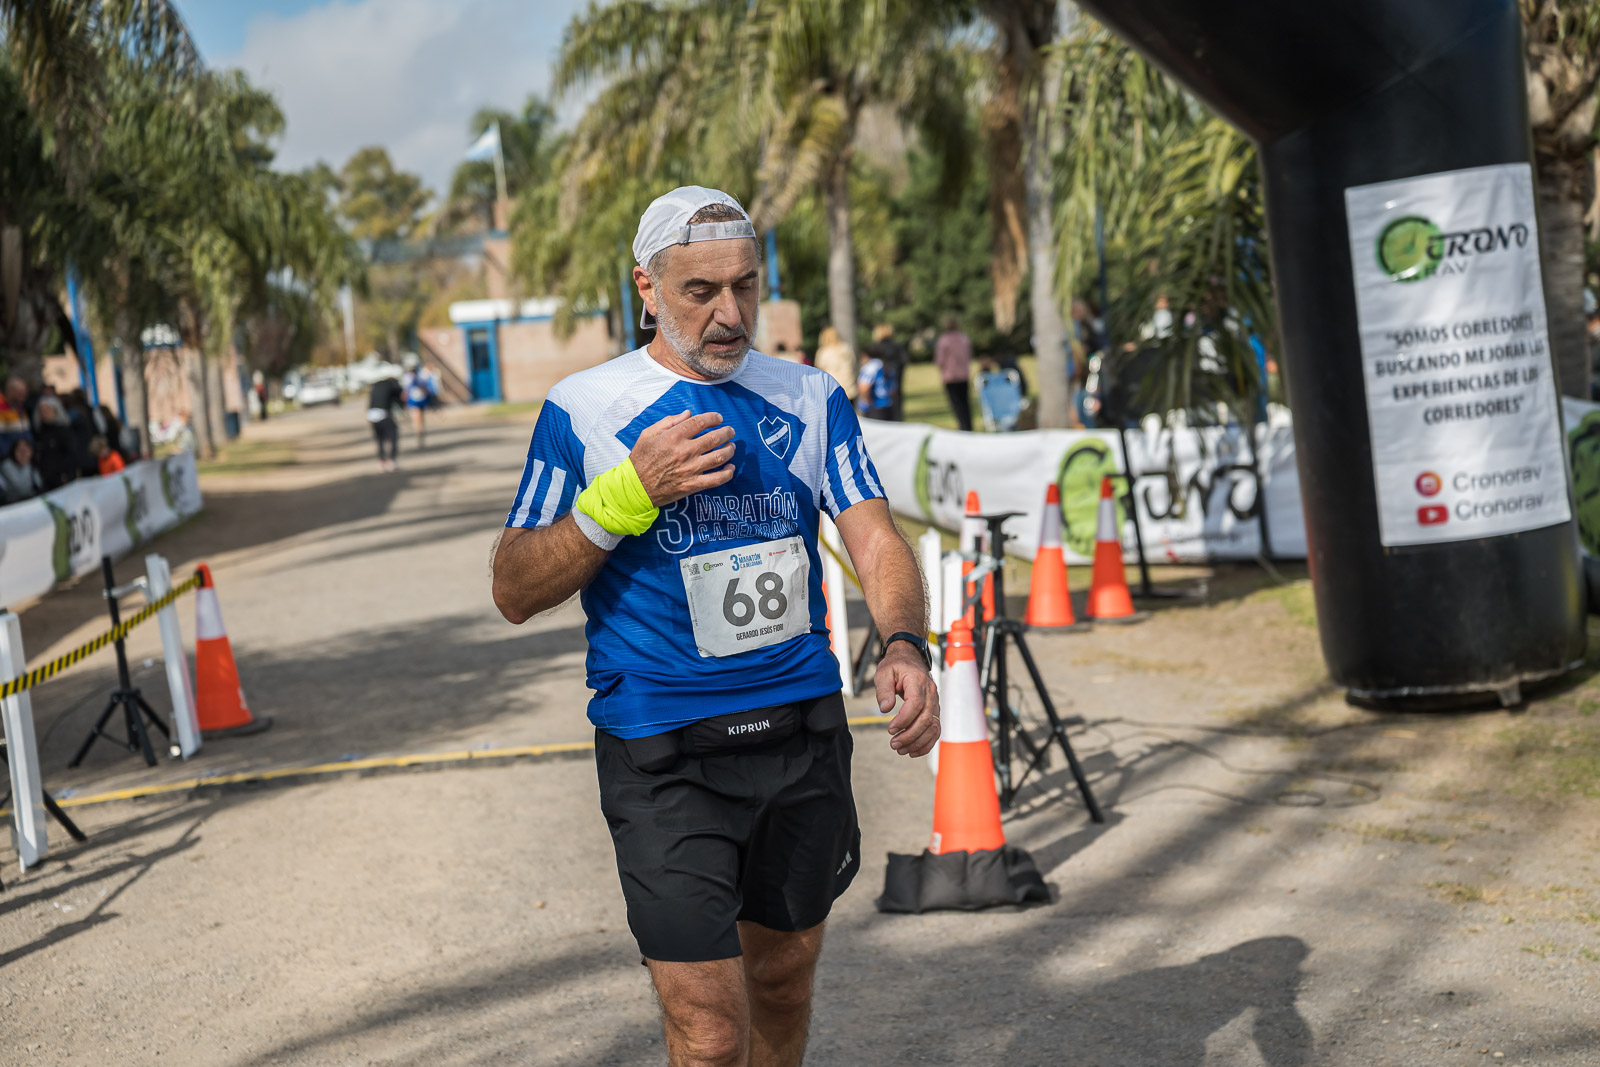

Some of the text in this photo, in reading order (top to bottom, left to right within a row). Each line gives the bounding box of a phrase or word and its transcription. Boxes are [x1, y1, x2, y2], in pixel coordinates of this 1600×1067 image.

[1375, 352, 1461, 378] BUSCANDO
[1393, 373, 1500, 402] EXPERIENCIAS
[1503, 370, 1519, 386] DE
[1452, 465, 1542, 493] Cronorav
[694, 486, 799, 523] MARATÓN
[1455, 493, 1544, 521] Cronorav
[730, 554, 740, 571] 3
[722, 571, 788, 627] 68
[727, 719, 771, 736] KIPRUN
